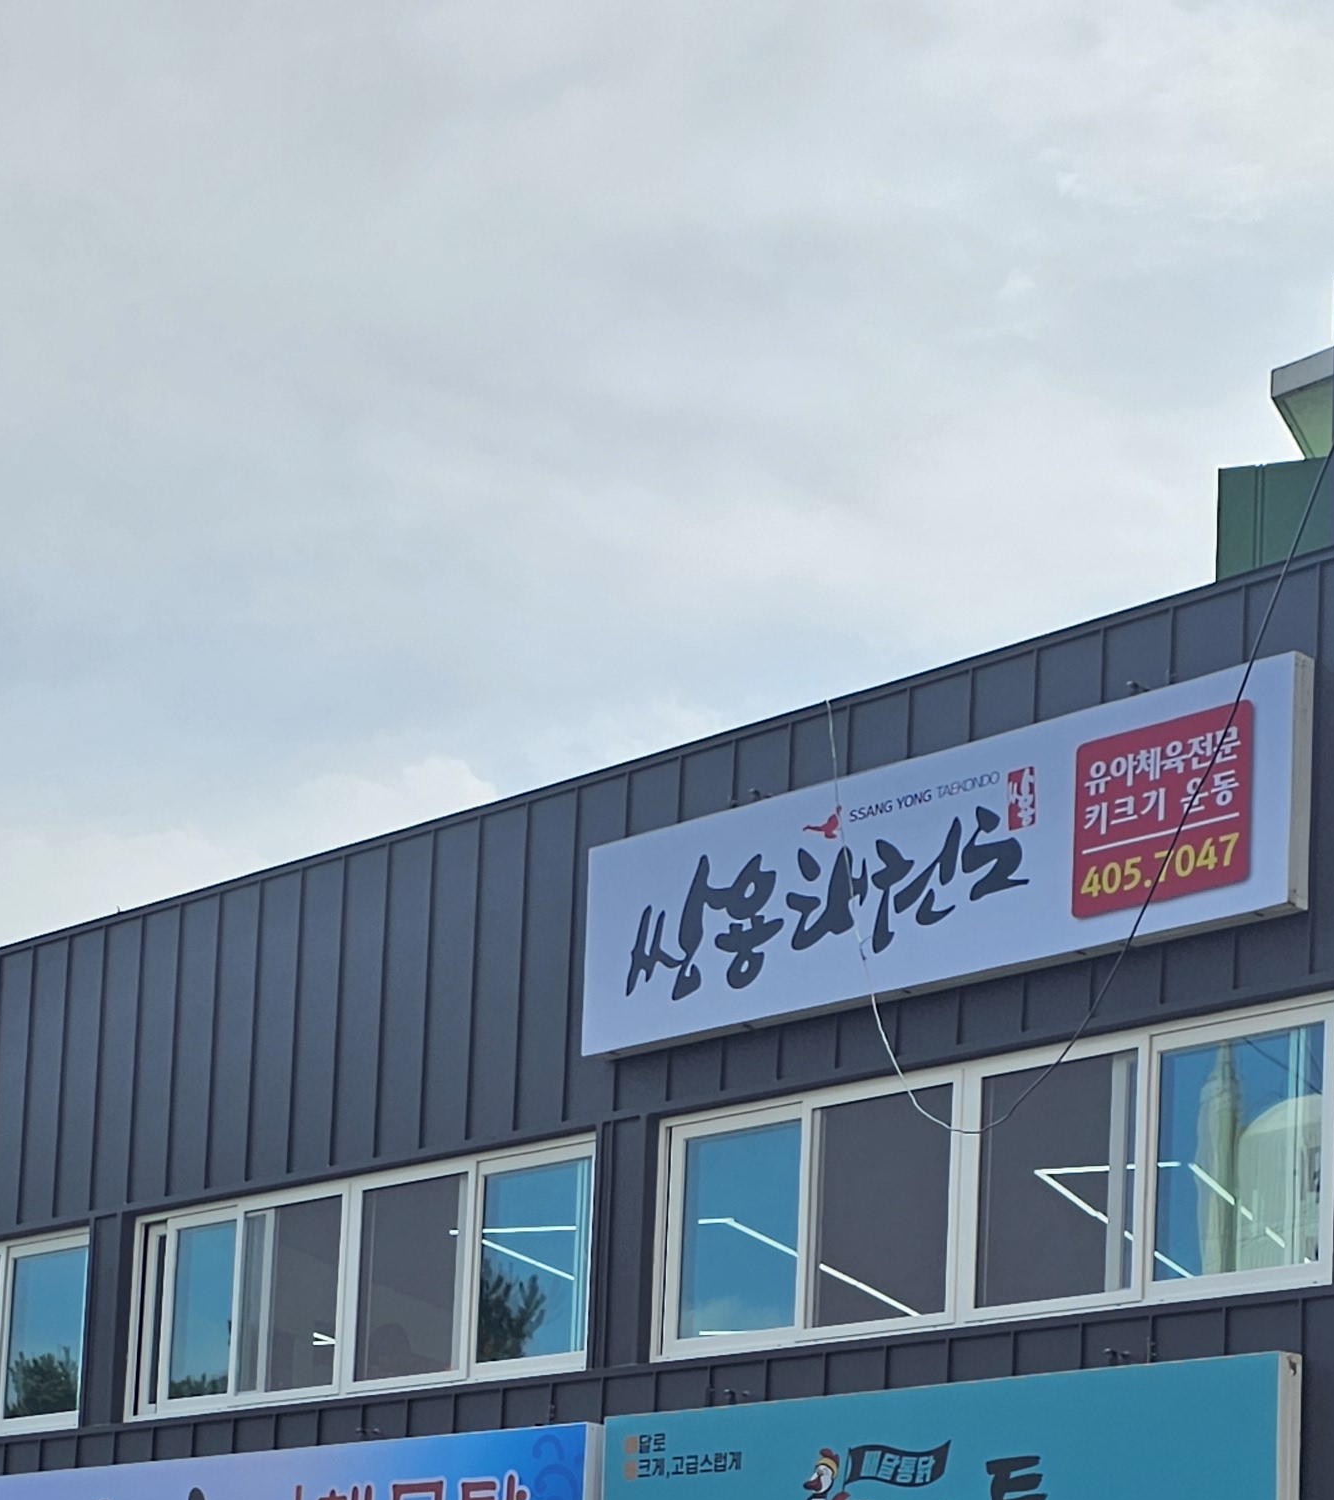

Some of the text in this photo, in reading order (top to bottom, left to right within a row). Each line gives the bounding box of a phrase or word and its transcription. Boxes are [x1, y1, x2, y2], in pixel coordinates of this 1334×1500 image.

[1084, 726, 1241, 796] 유아체육전문
[849, 800, 893, 822] SSANG
[896, 790, 932, 811] YONG
[1083, 769, 1240, 835] 키크기 운동
[1080, 832, 1239, 897] 405.7047
